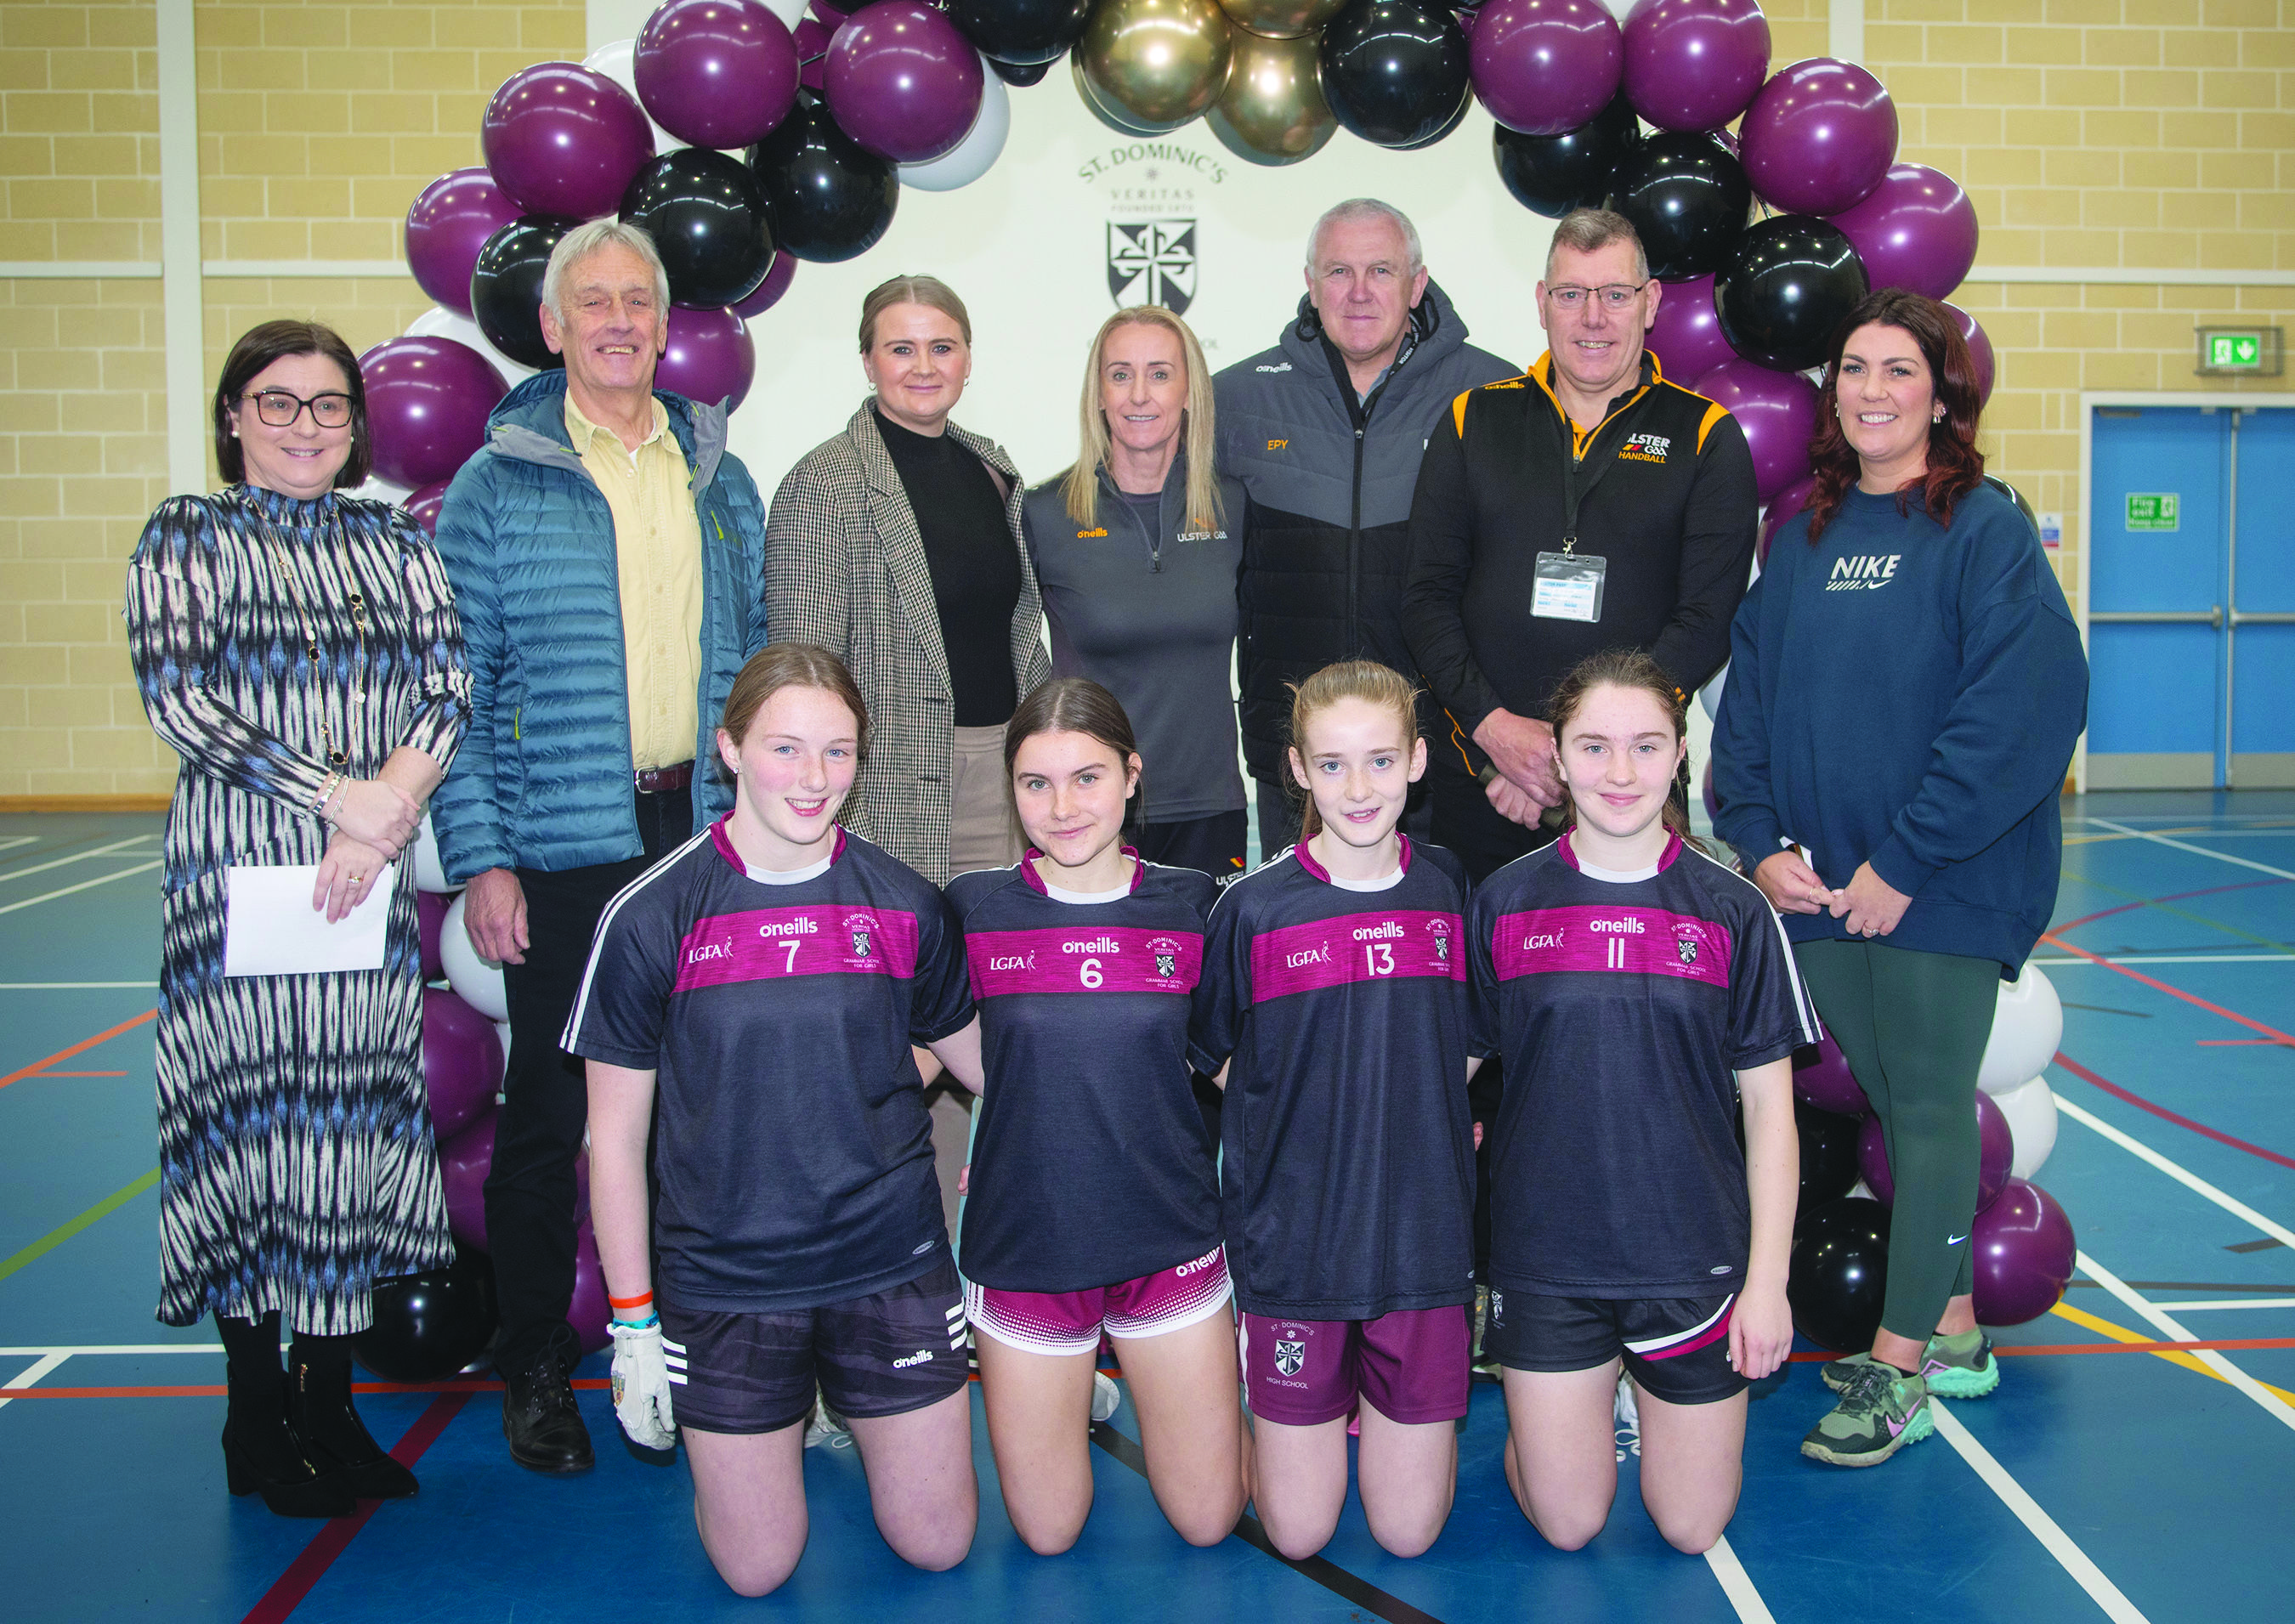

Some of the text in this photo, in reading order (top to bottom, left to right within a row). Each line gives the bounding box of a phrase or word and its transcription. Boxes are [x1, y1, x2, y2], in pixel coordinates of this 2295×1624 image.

[1079, 143, 1228, 184] ST. DOMINIC'S
[1111, 188, 1195, 200] VERITAS
[1267, 439, 1289, 450] EPY
[1618, 450, 1666, 464] HANDBALL
[1076, 527, 1108, 539] o'neills
[1176, 531, 1211, 542] ULSTER
[1830, 554, 1902, 580] NIKE
[759, 916, 819, 937] o'neills
[1352, 920, 1405, 941] o'neills
[1590, 917, 1646, 934] o'neills
[1062, 936, 1120, 953] o'neills
[1523, 935, 1555, 950] LGFA
[688, 944, 723, 964] LGFA
[779, 940, 801, 973] 7
[1286, 949, 1322, 968] LGFA
[1365, 943, 1395, 976] 13
[1607, 937, 1624, 969] 11
[990, 956, 1026, 970] LGFA
[1080, 958, 1103, 989] 6
[1282, 1321, 1315, 1337] DOMINIC'S
[892, 1349, 934, 1369] o'neills
[1266, 1376, 1309, 1389] HIGH SCHOOL
